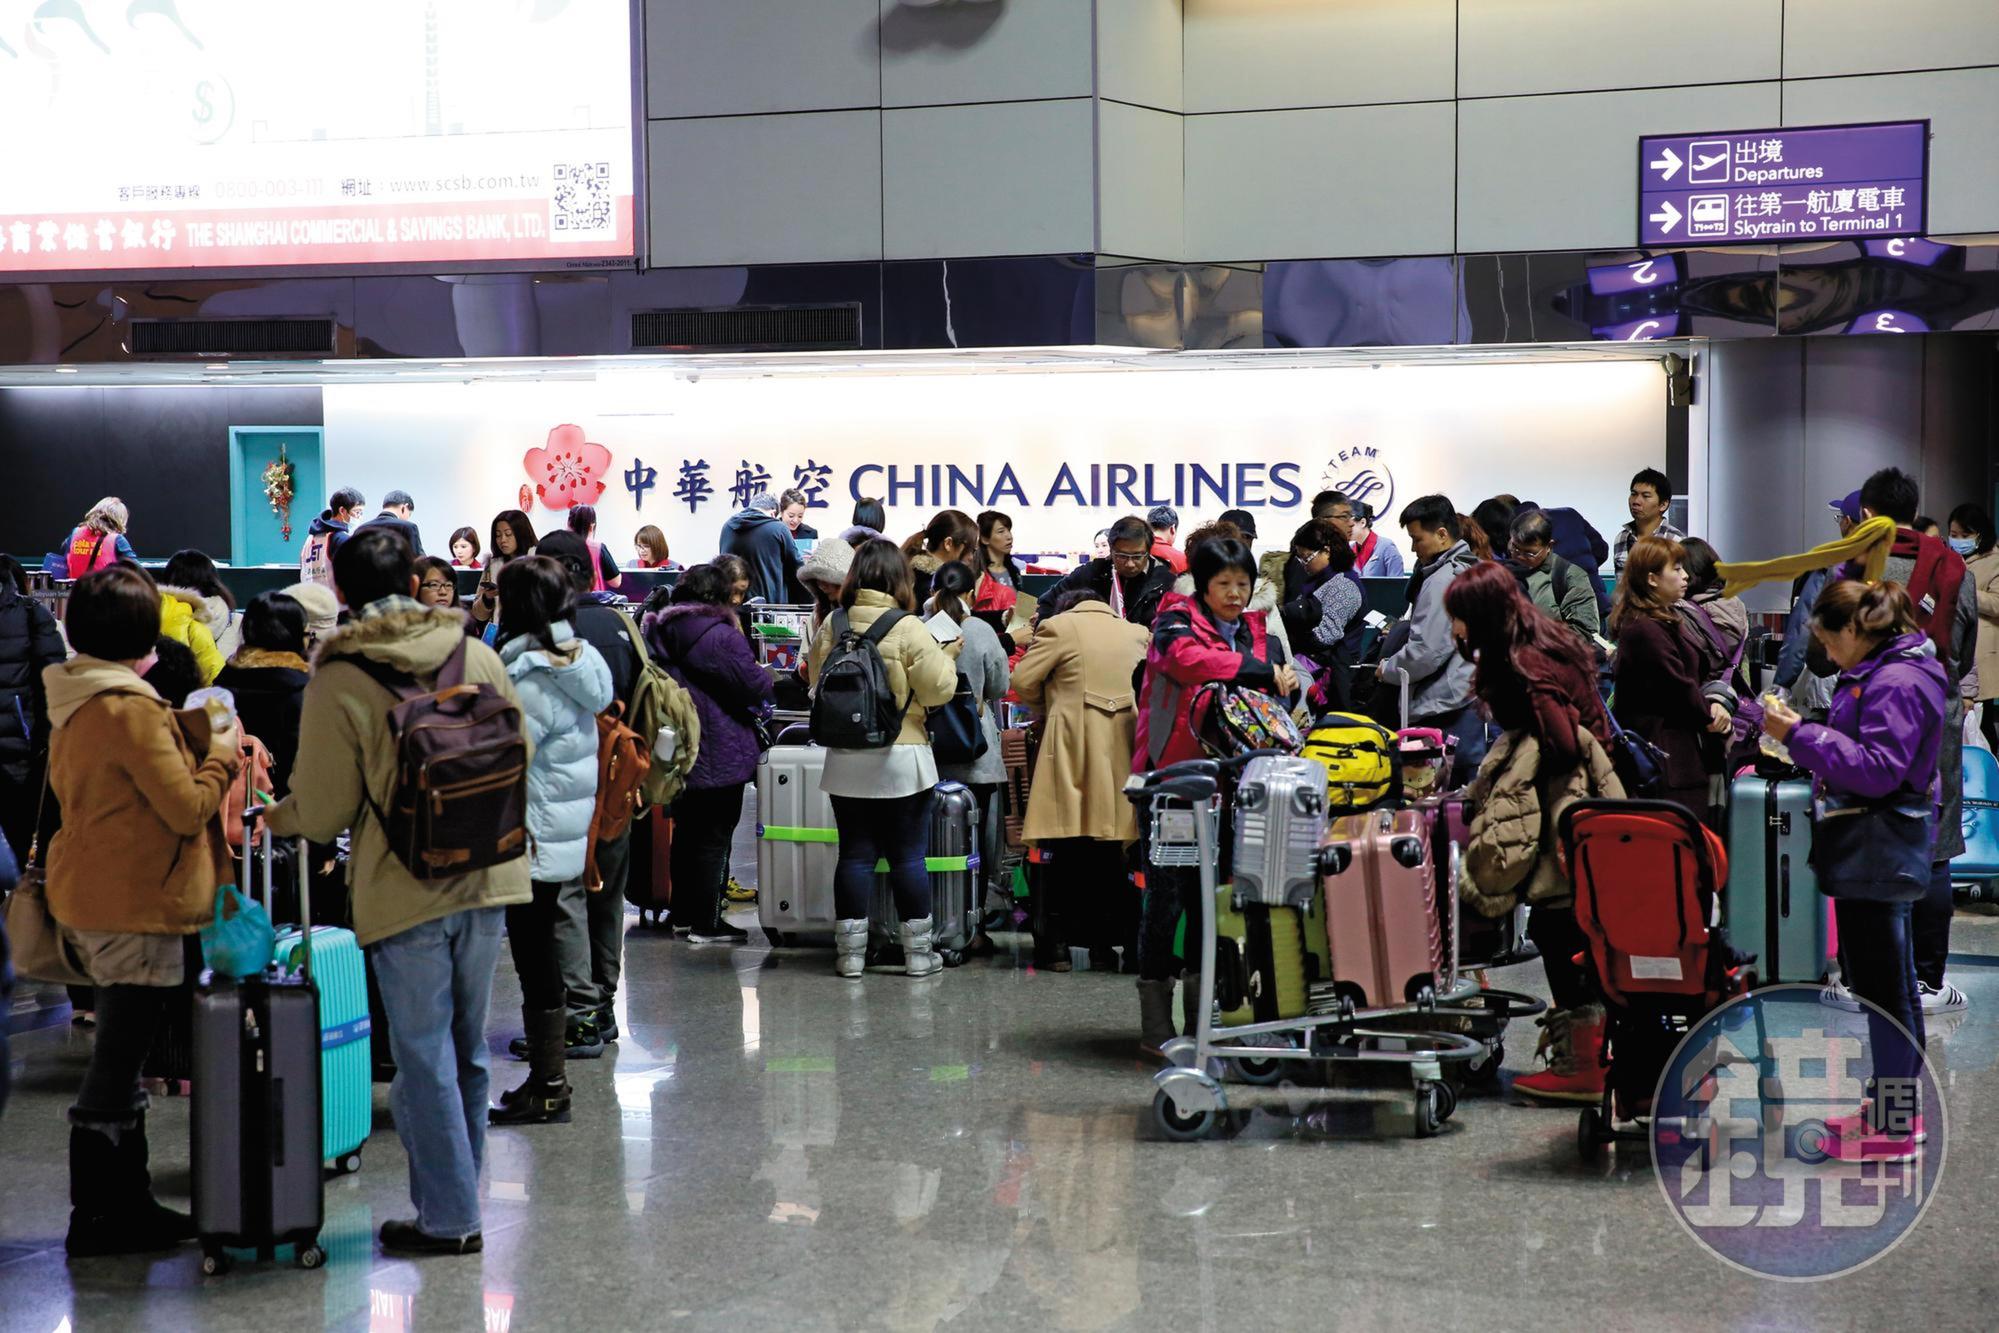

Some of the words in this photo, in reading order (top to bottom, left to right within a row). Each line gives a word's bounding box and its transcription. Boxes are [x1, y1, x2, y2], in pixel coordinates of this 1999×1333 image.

[1735, 139, 1783, 164] 出境
[1735, 165, 1823, 184] Departures
[1735, 186, 1905, 217] 往第一航廈電車
[186, 222, 214, 247] THE
[216, 220, 288, 246] SHANGHAI
[290, 217, 384, 246] COMMERCIAL
[387, 216, 398, 242] &
[400, 214, 462, 243] SAVINGS
[466, 213, 511, 243] BANK,
[514, 212, 546, 239] LTD.
[1734, 219, 1795, 236] Skytrain
[1799, 219, 1817, 233] to
[1819, 214, 1889, 231] Terminal
[1895, 213, 1903, 228] 1
[849, 462, 1030, 507] CHINA
[1043, 462, 1301, 507] AIRLINES
[1321, 446, 1378, 490] YTEAM
[624, 458, 832, 513] 中華航空
